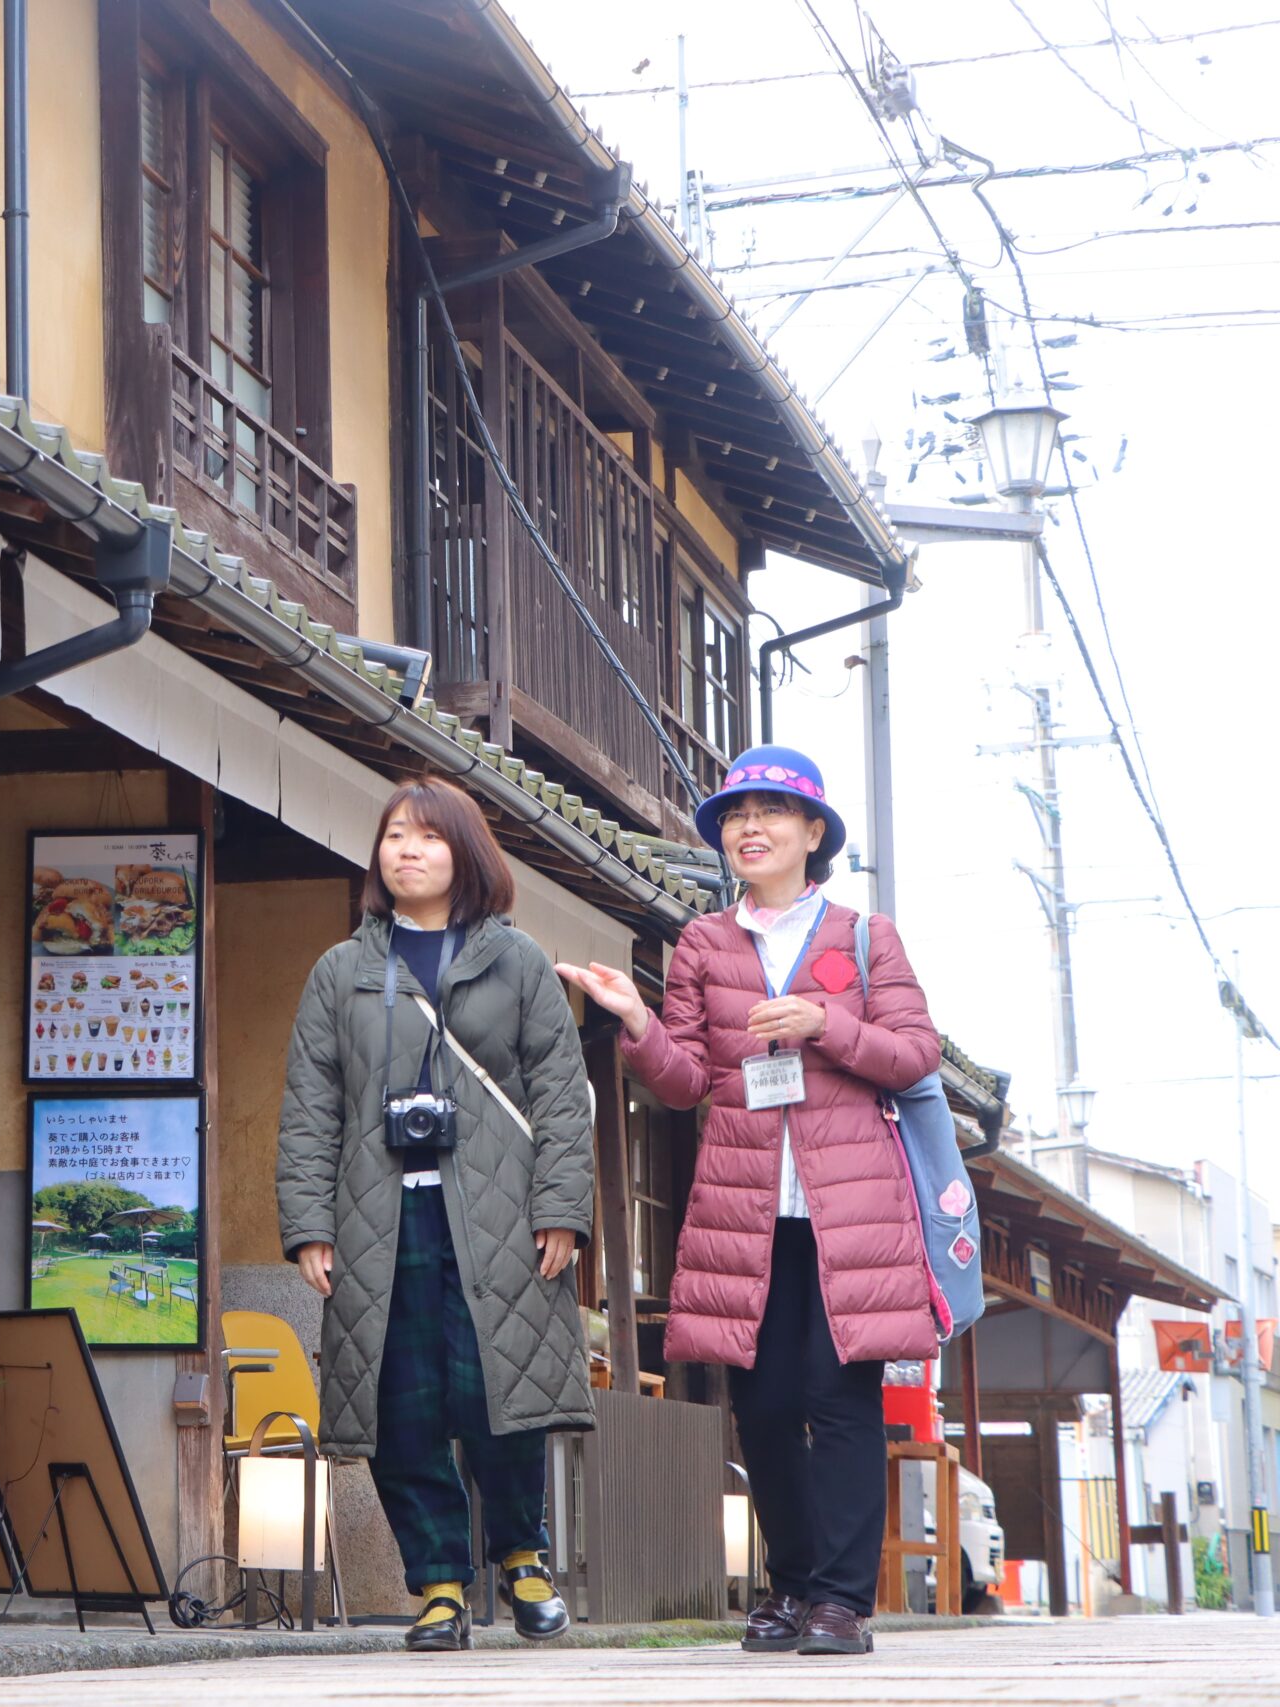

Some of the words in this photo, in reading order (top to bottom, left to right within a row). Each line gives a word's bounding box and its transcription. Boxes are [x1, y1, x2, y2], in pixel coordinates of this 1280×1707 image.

[46, 1114, 128, 1124] いらっしゃいませ
[48, 1131, 140, 1143] 葵でご購入のお客様
[48, 1144, 134, 1155] 12時から15時まで
